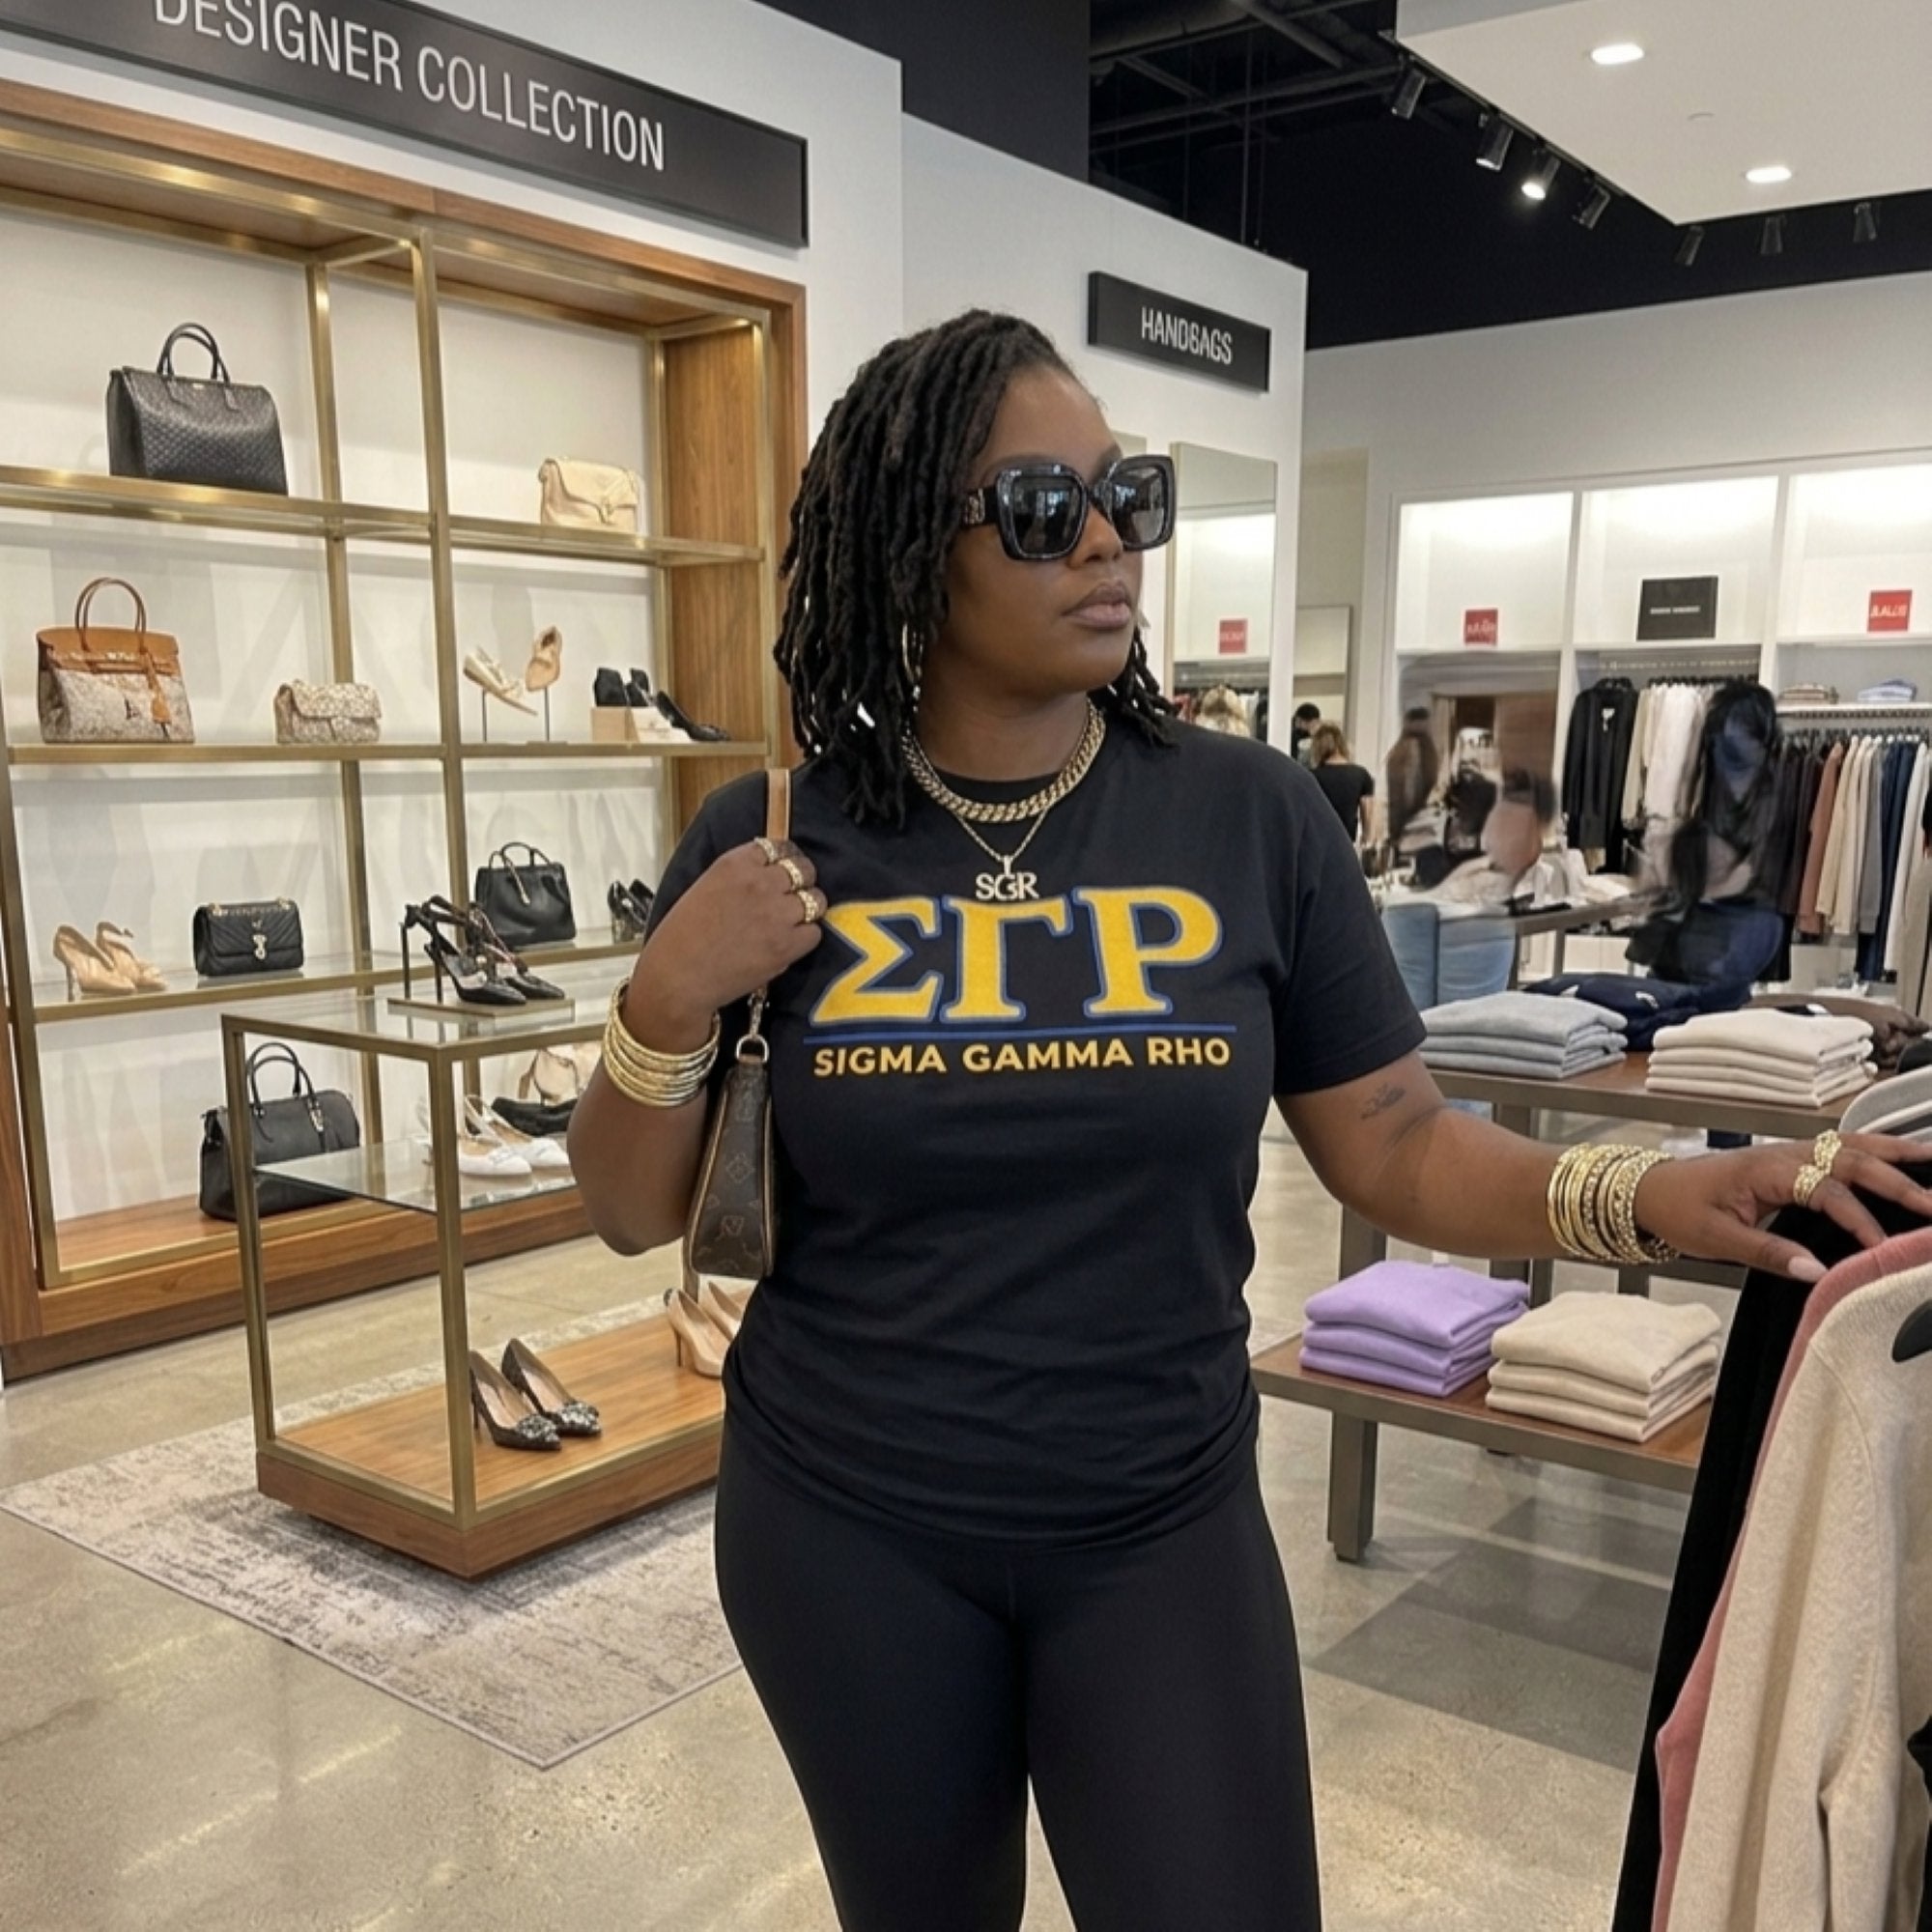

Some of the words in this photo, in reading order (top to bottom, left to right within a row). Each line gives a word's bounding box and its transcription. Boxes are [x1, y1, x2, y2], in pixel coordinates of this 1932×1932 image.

[417, 46, 666, 172] COLLECTION
[1141, 305, 1233, 365] HANDBAGS
[975, 873, 1039, 900] SGR
[813, 1044, 947, 1077] SIGMA
[962, 1038, 1134, 1072] GAMMA
[1147, 1037, 1232, 1068] RHO
